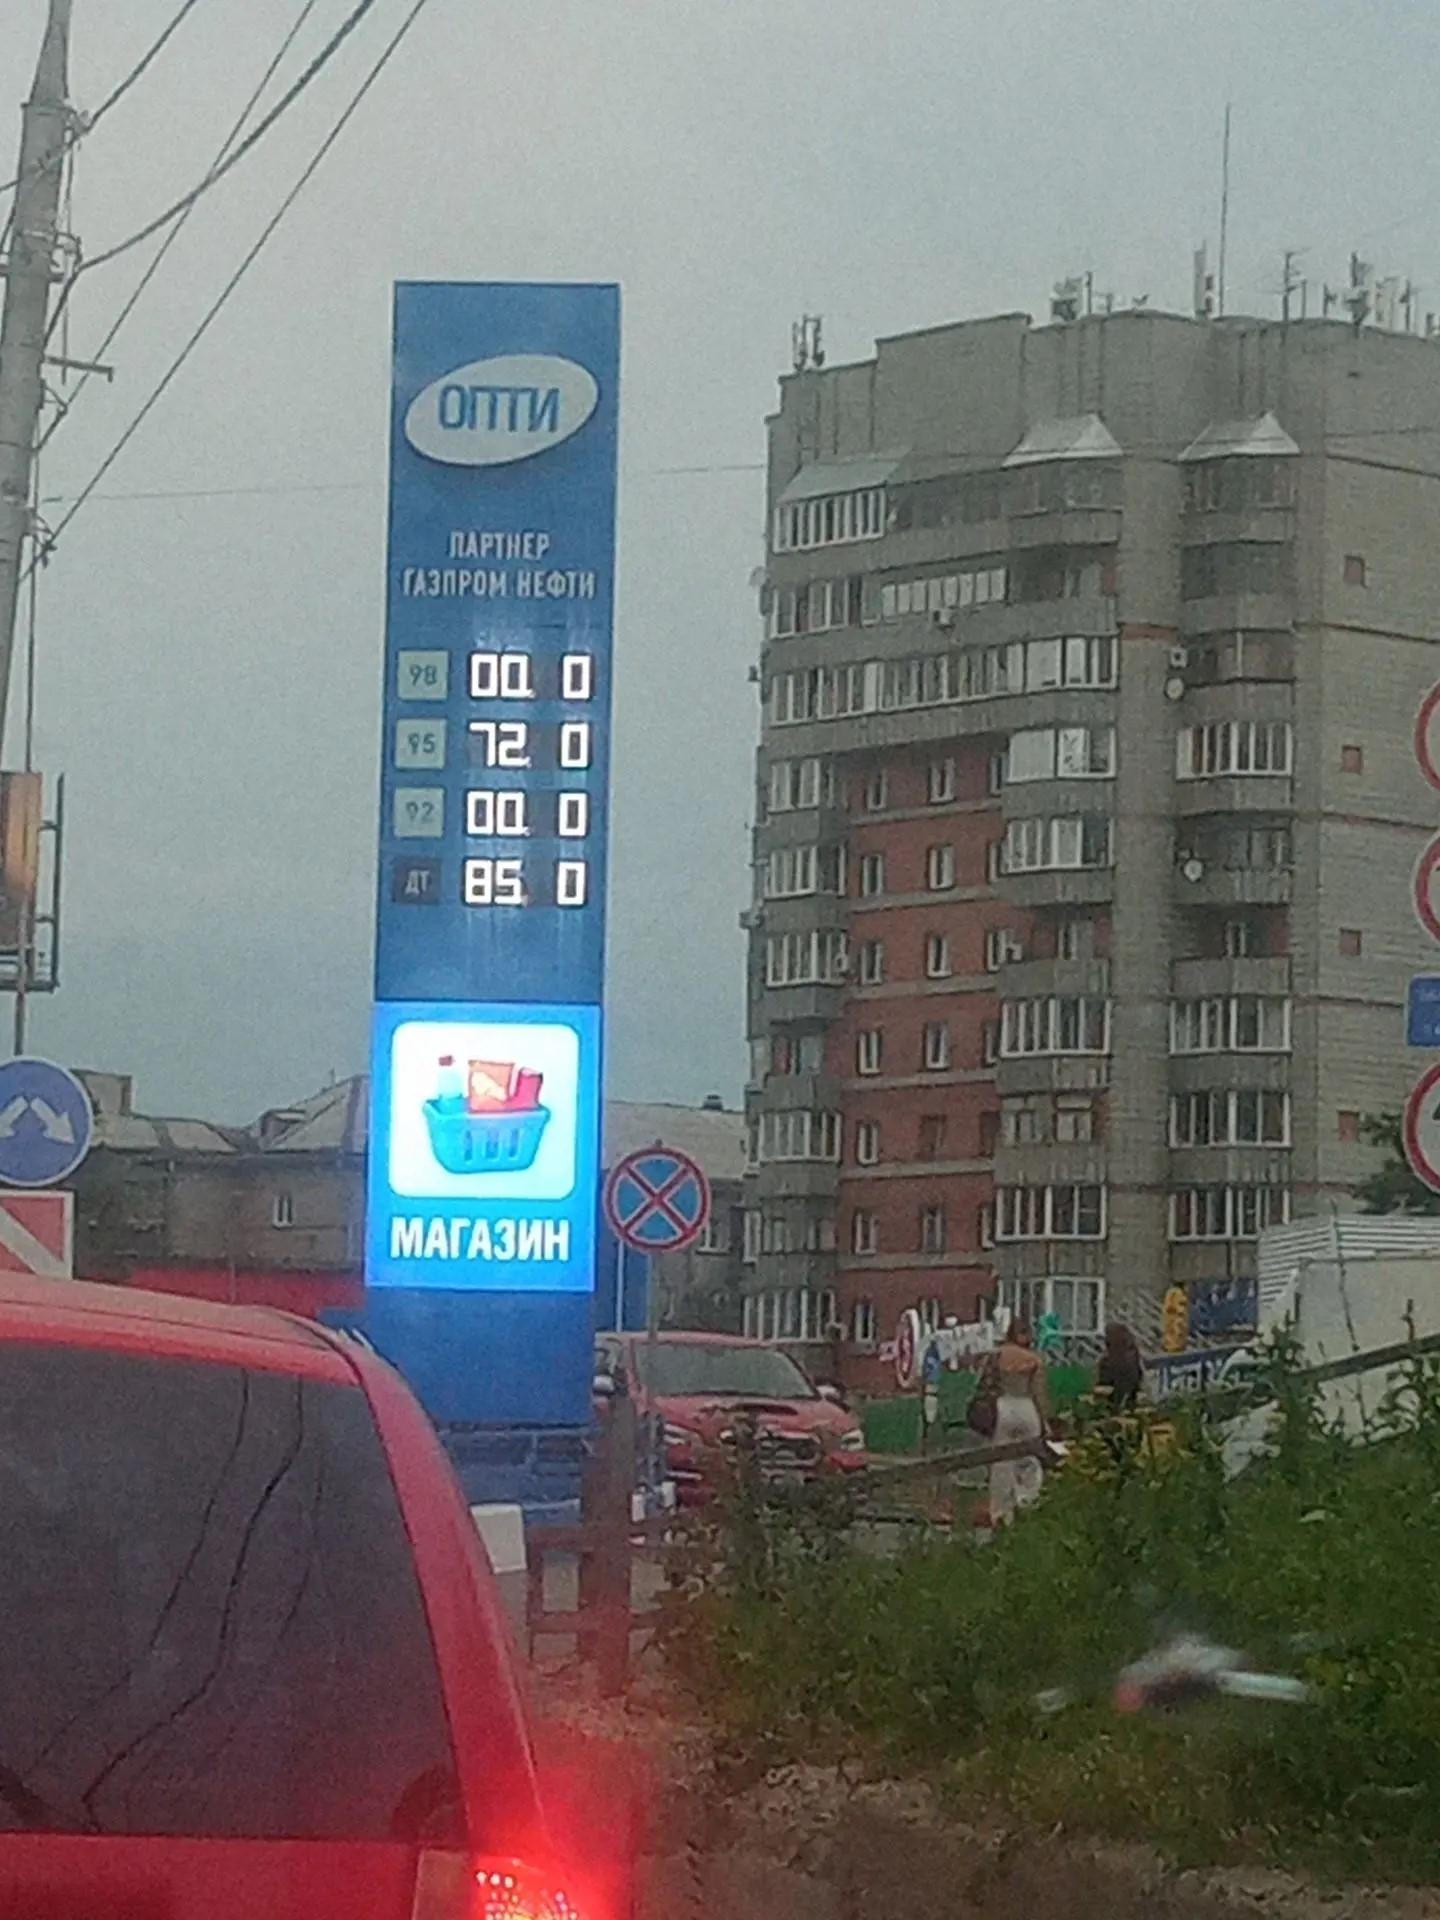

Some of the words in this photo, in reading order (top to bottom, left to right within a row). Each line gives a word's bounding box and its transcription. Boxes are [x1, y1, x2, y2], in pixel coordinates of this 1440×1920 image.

[438, 384, 560, 433] ОПТИ
[449, 531, 551, 561] ПАРТНЕР
[402, 567, 508, 598] ГАЗПРОМ
[516, 570, 596, 600] НЕФТИ
[409, 665, 438, 687] 98
[407, 733, 436, 755] 95
[405, 870, 430, 895] ДТ
[389, 1215, 570, 1262] МАГАЗИН
